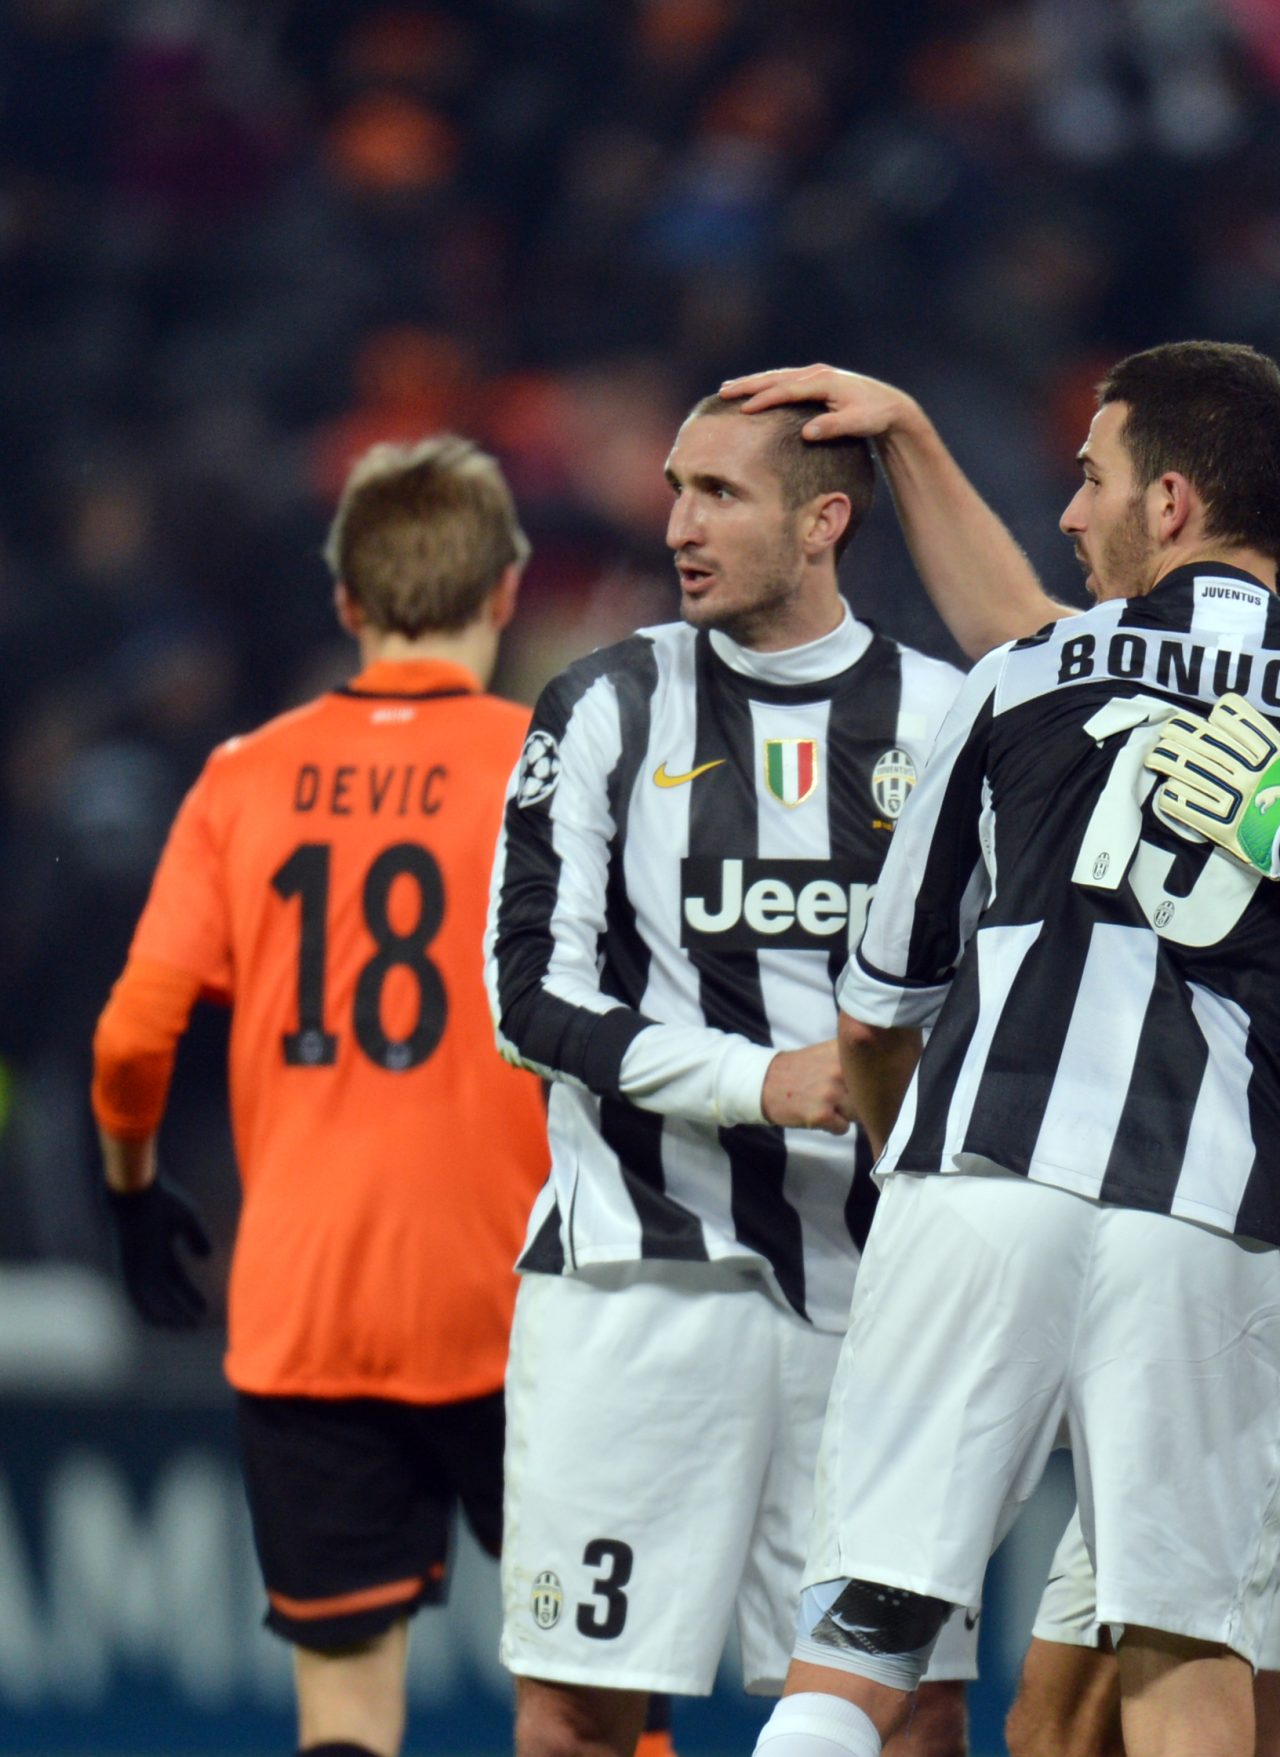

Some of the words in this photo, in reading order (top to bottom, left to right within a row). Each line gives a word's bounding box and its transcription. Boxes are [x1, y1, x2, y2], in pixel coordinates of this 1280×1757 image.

[1201, 586, 1262, 606] JUVENTUS
[293, 763, 450, 816] DEVIC
[269, 840, 449, 1073] 18
[575, 1537, 634, 1641] 3
